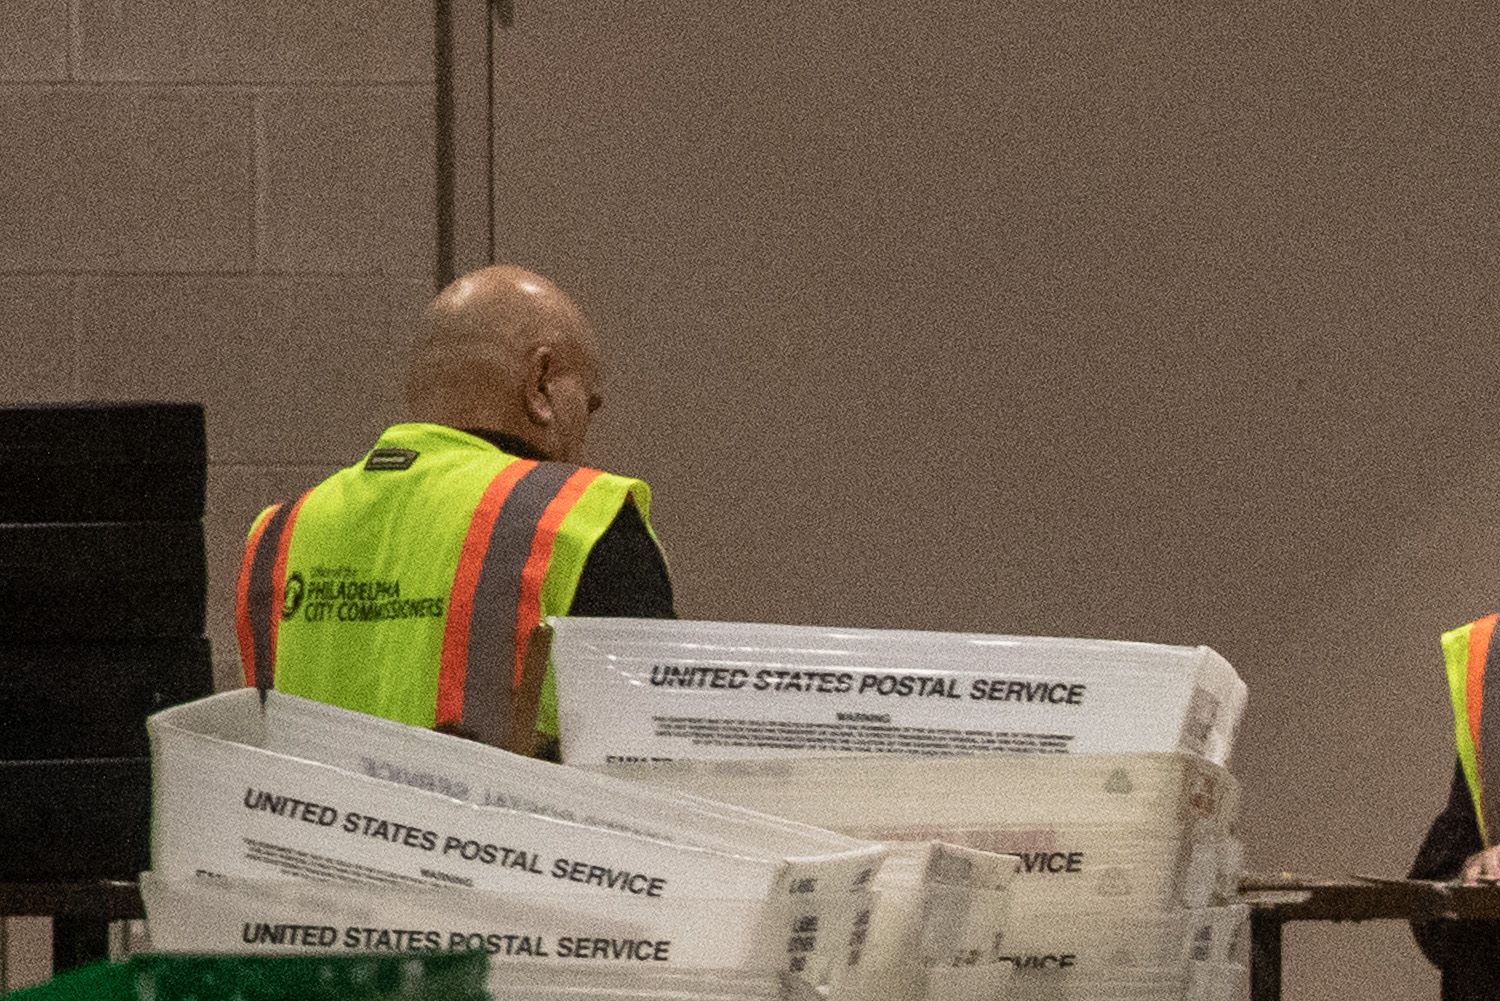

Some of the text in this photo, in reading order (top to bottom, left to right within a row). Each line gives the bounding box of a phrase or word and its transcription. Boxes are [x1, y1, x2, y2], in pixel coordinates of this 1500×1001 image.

[304, 598, 444, 622] CITY COMMISSIONERS
[307, 581, 400, 601] PHILADELPHIA
[650, 664, 1086, 706] UNITED STATES POSTAL SERVICE
[243, 788, 339, 828] UNITED
[343, 812, 437, 852] STATES
[443, 836, 544, 875] POSTAL
[550, 858, 668, 898] SERVICE
[242, 922, 671, 962] UNITED STATES POSTAL SERVICE
